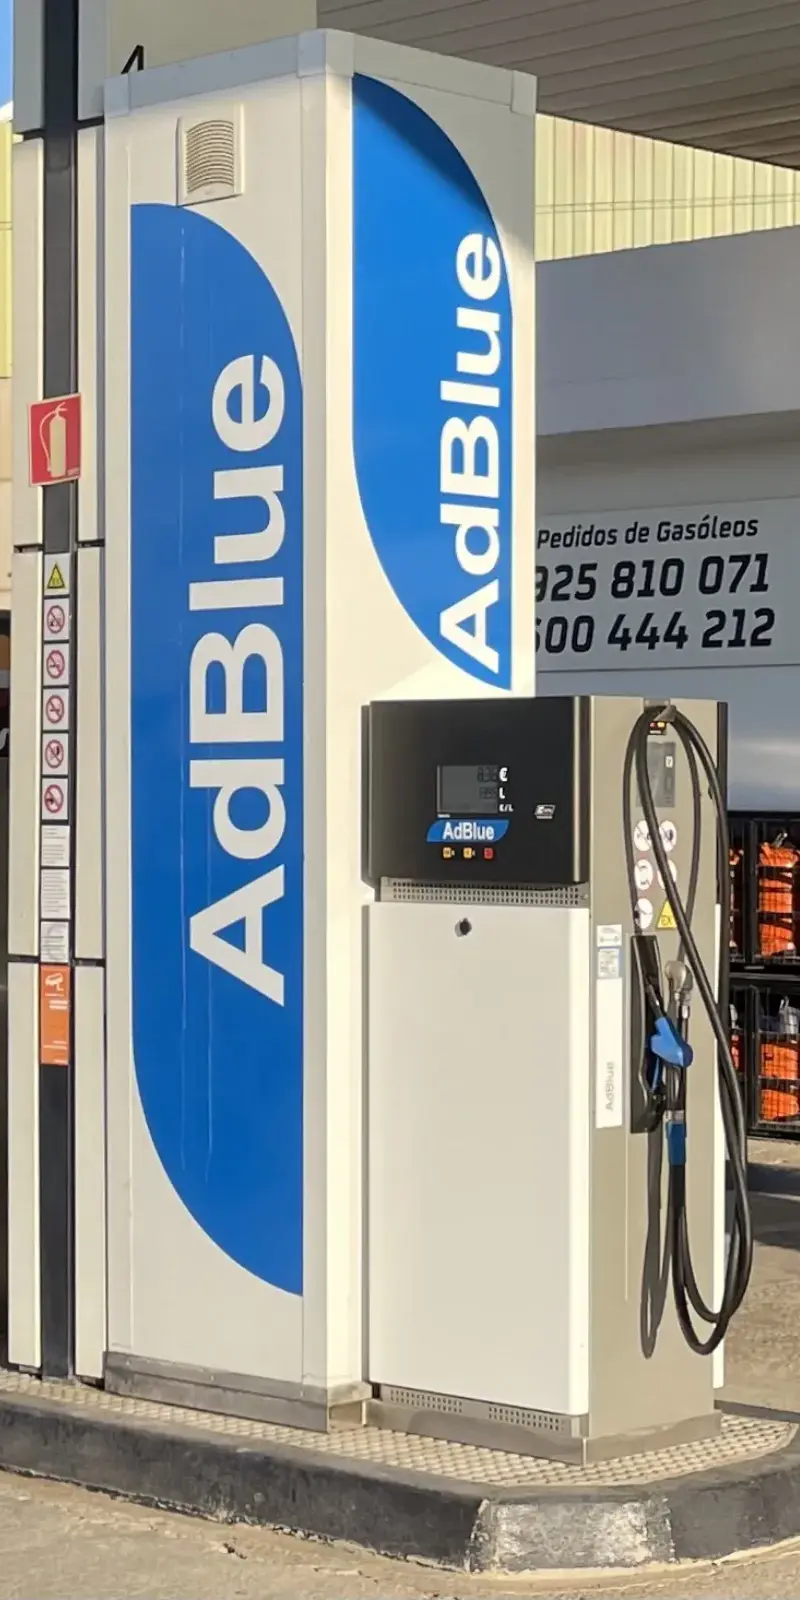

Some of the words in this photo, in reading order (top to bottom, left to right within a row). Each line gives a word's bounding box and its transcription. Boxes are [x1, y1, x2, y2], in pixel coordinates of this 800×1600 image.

[440, 233, 501, 674] AdBlue
[537, 525, 617, 549] Pedidos
[625, 522, 649, 544] de
[657, 515, 758, 542] Gasóleos
[611, 558, 684, 599] 810
[699, 553, 769, 594] 071
[607, 611, 688, 651] 444
[702, 608, 775, 648] 212
[189, 354, 285, 1007] AdBlue
[442, 821, 495, 840] AdBlue
